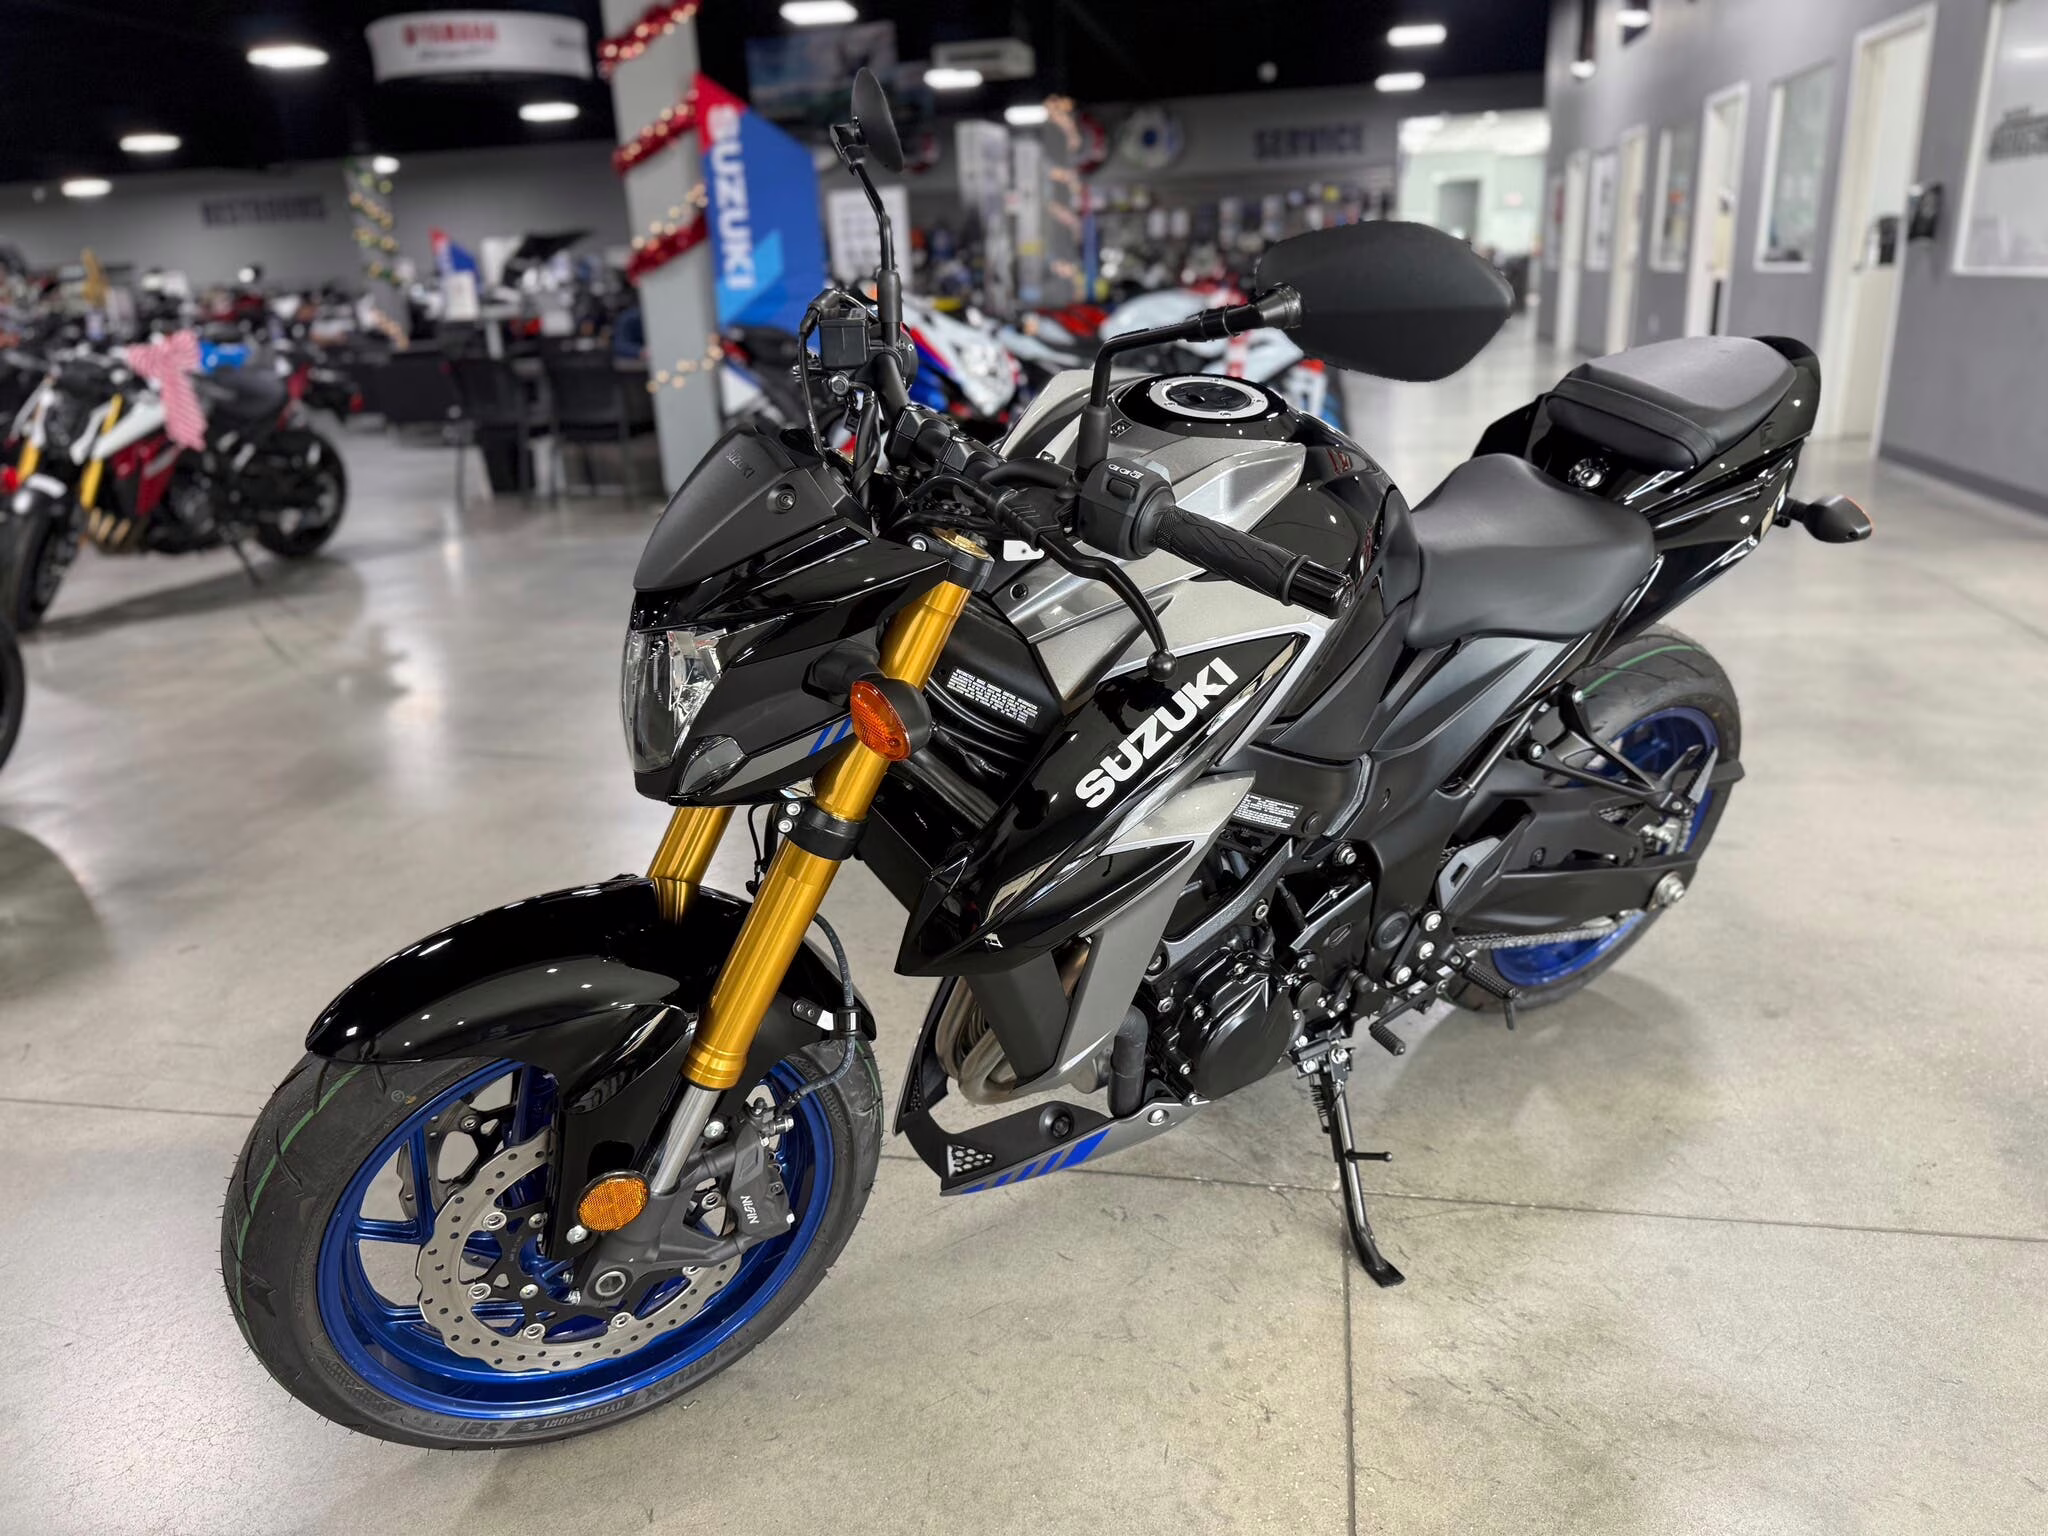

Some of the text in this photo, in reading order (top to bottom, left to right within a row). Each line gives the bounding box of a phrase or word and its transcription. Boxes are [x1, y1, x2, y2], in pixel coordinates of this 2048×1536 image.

[1253, 124, 1364, 159] SERVICE
[706, 103, 756, 289] SUZUKI
[1075, 656, 1239, 809] SUZUKI
[740, 1195, 760, 1224] NISSIN
[542, 1399, 626, 1429] HYPERSPORT
